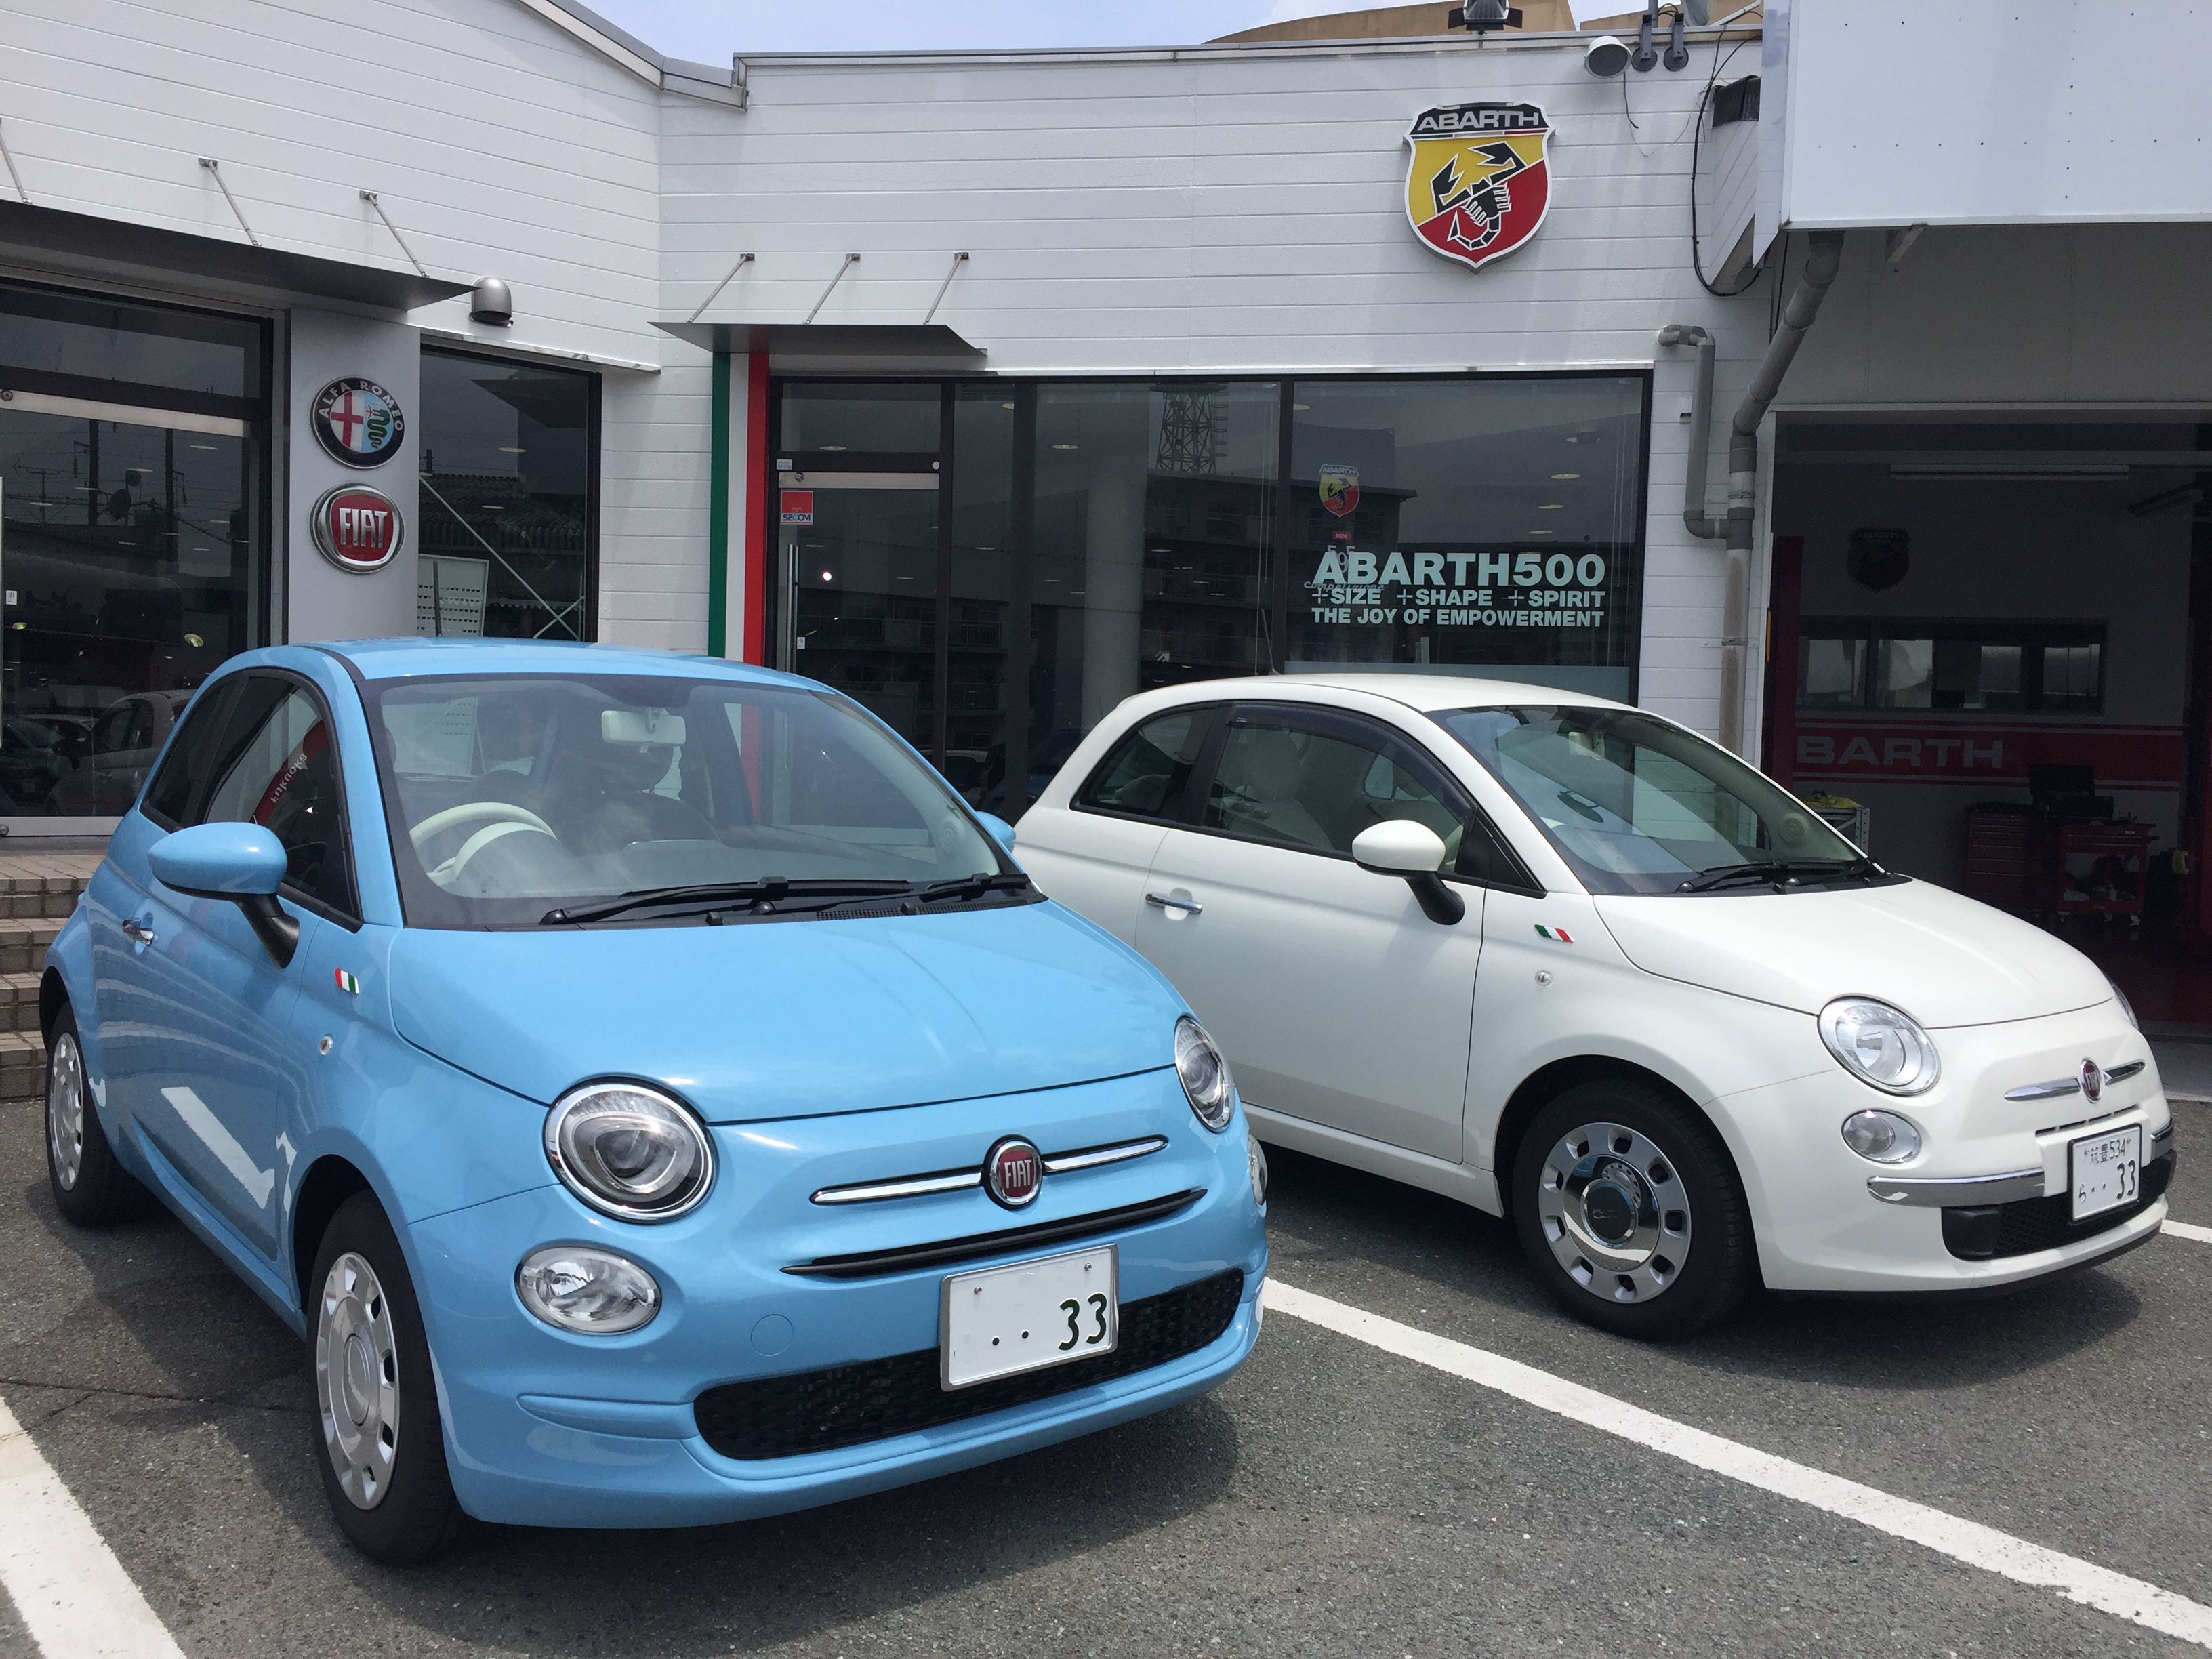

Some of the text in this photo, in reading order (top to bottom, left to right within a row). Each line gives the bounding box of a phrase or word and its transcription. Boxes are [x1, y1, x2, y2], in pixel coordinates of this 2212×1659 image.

[1417, 110, 1540, 131] ABARTH
[318, 380, 404, 432] ALFA ROMEO
[339, 507, 388, 549] FIAT
[783, 514, 811, 522] SECOM
[1312, 552, 1606, 586] ABARTH500
[1311, 607, 1605, 628] THE JOY OF EMPOWERMENT
[1004, 1158, 1032, 1189] FIAT
[1058, 1292, 1108, 1351] 33
